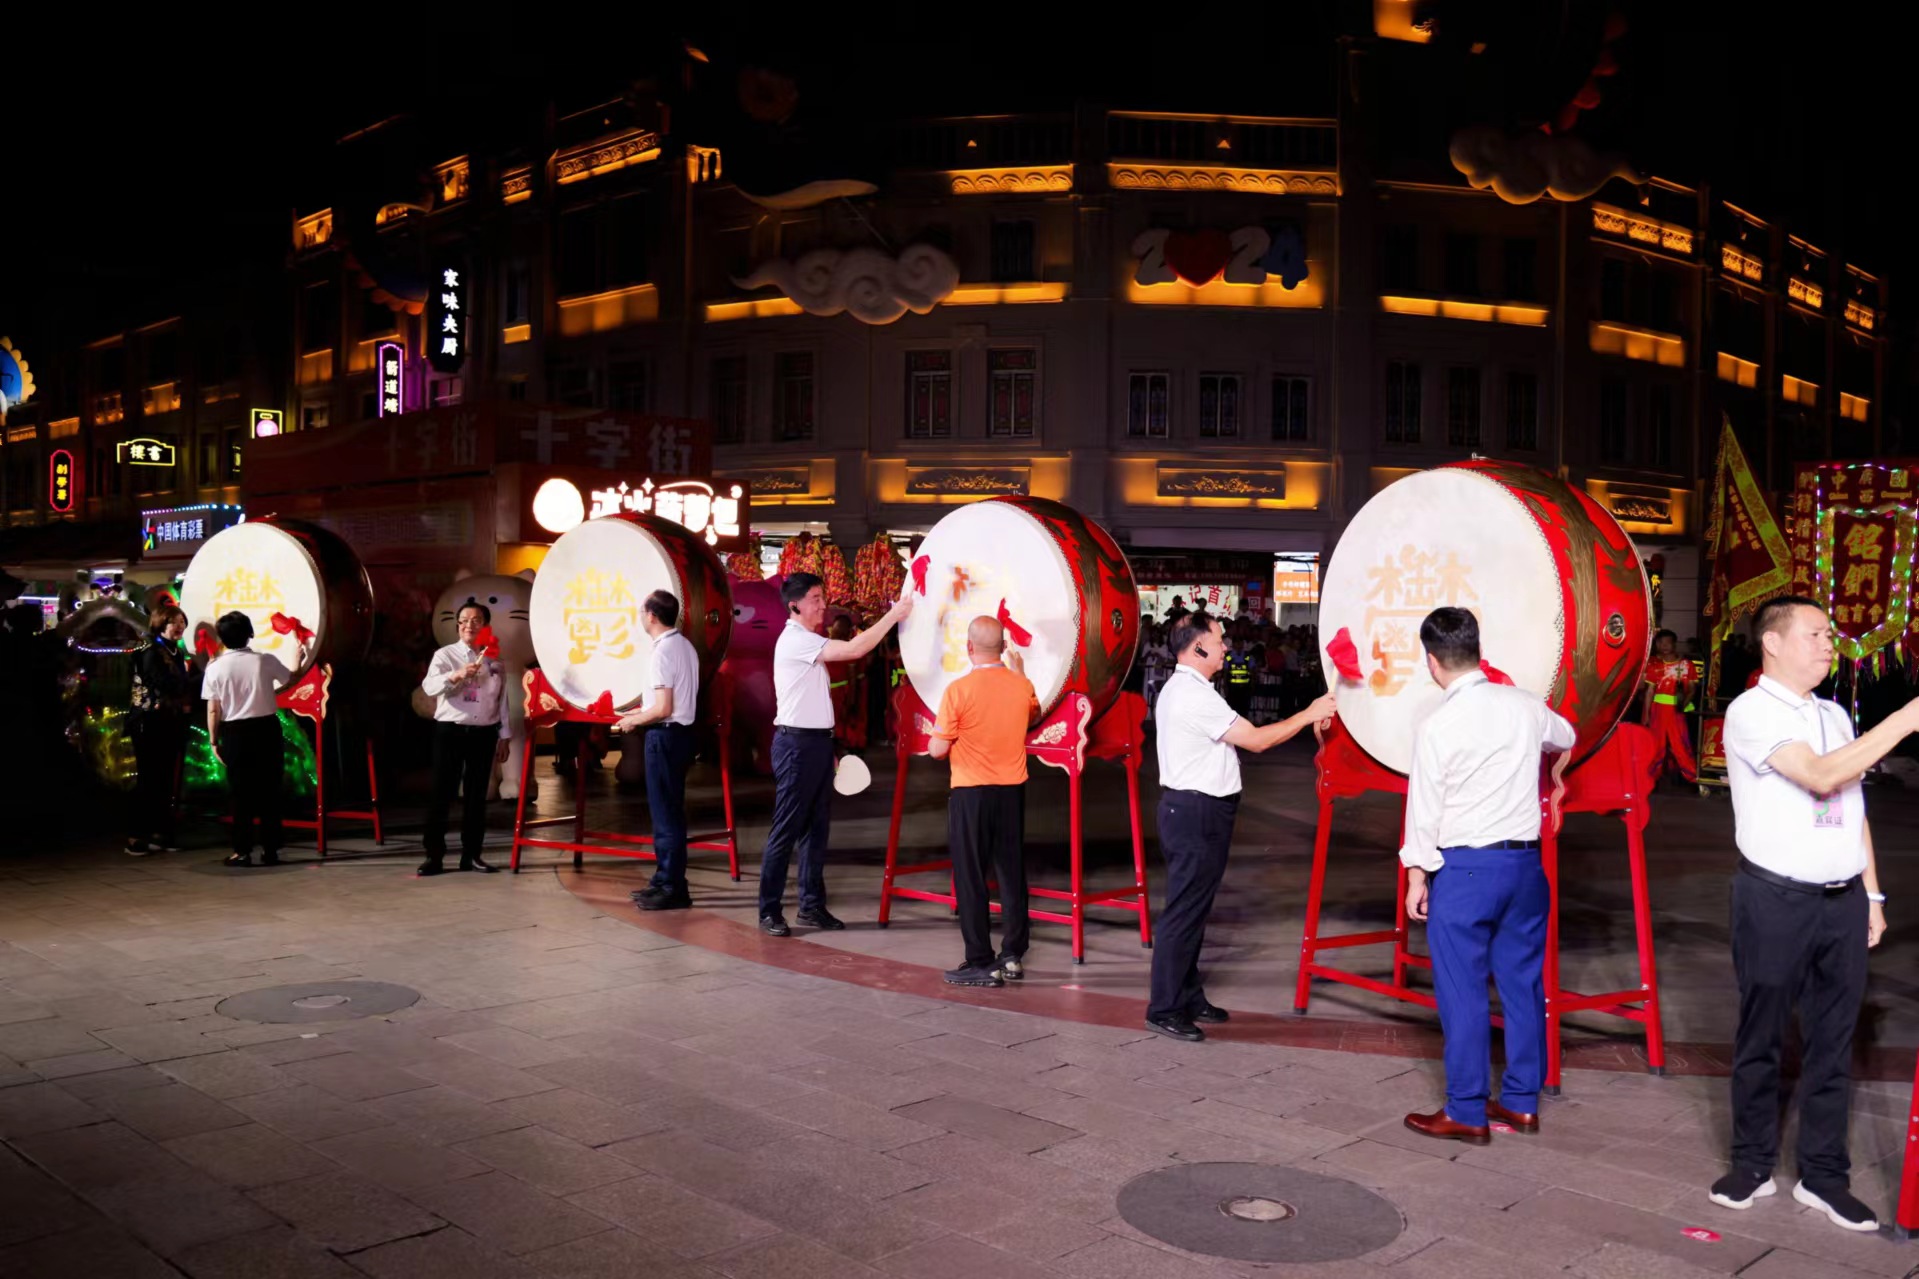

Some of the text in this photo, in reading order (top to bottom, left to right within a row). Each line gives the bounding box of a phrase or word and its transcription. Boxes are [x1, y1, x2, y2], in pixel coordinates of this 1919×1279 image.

[520, 410, 693, 475] 十字街
[157, 519, 204, 542] 中国体育彩票
